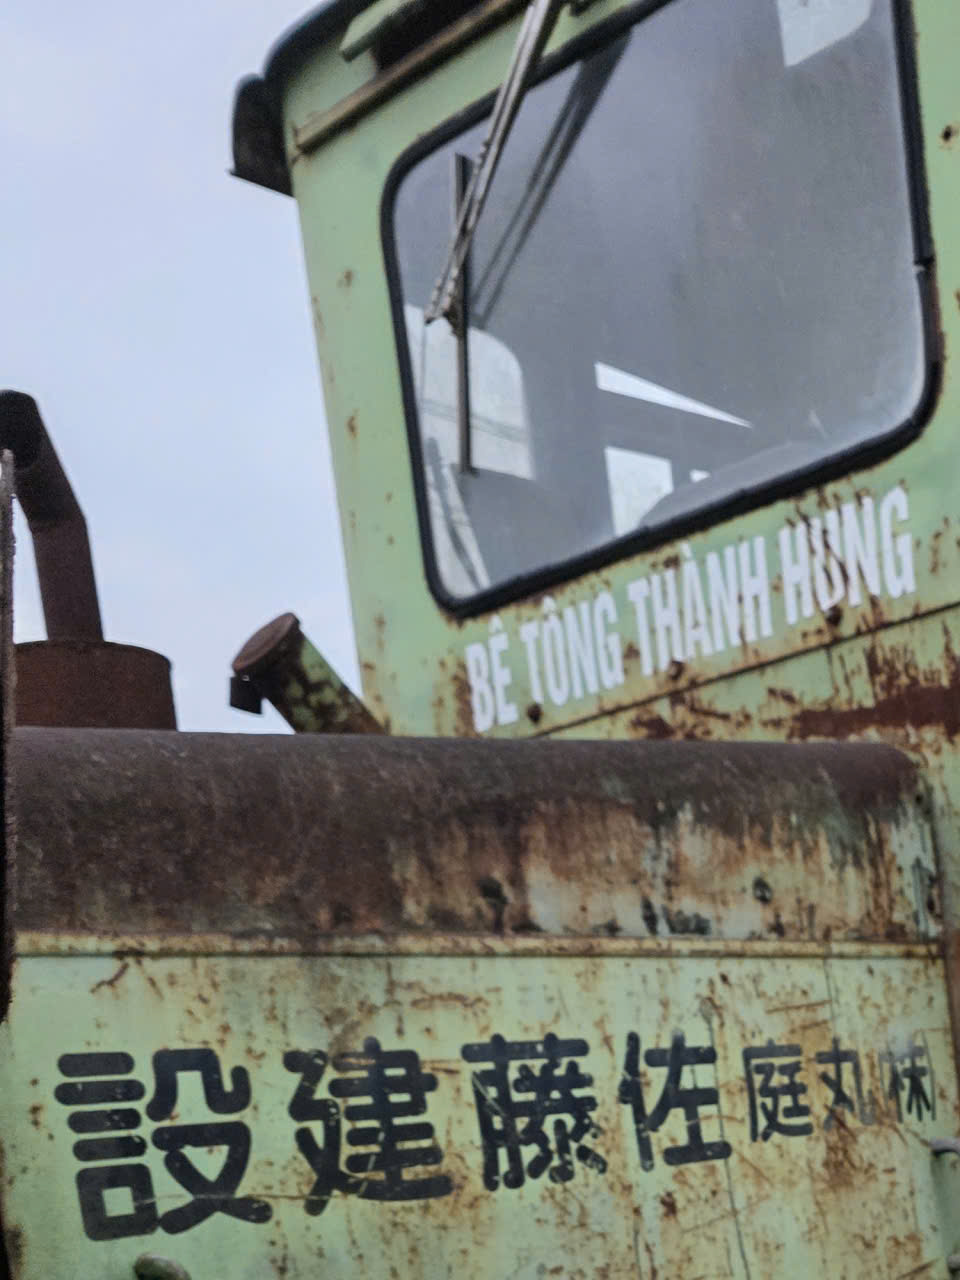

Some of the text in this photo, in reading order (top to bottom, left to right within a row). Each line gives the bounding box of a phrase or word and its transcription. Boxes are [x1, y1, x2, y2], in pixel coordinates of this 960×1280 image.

[465, 614, 520, 732] BÊ
[519, 592, 625, 706] TÔNG
[628, 536, 774, 676] THÀNH
